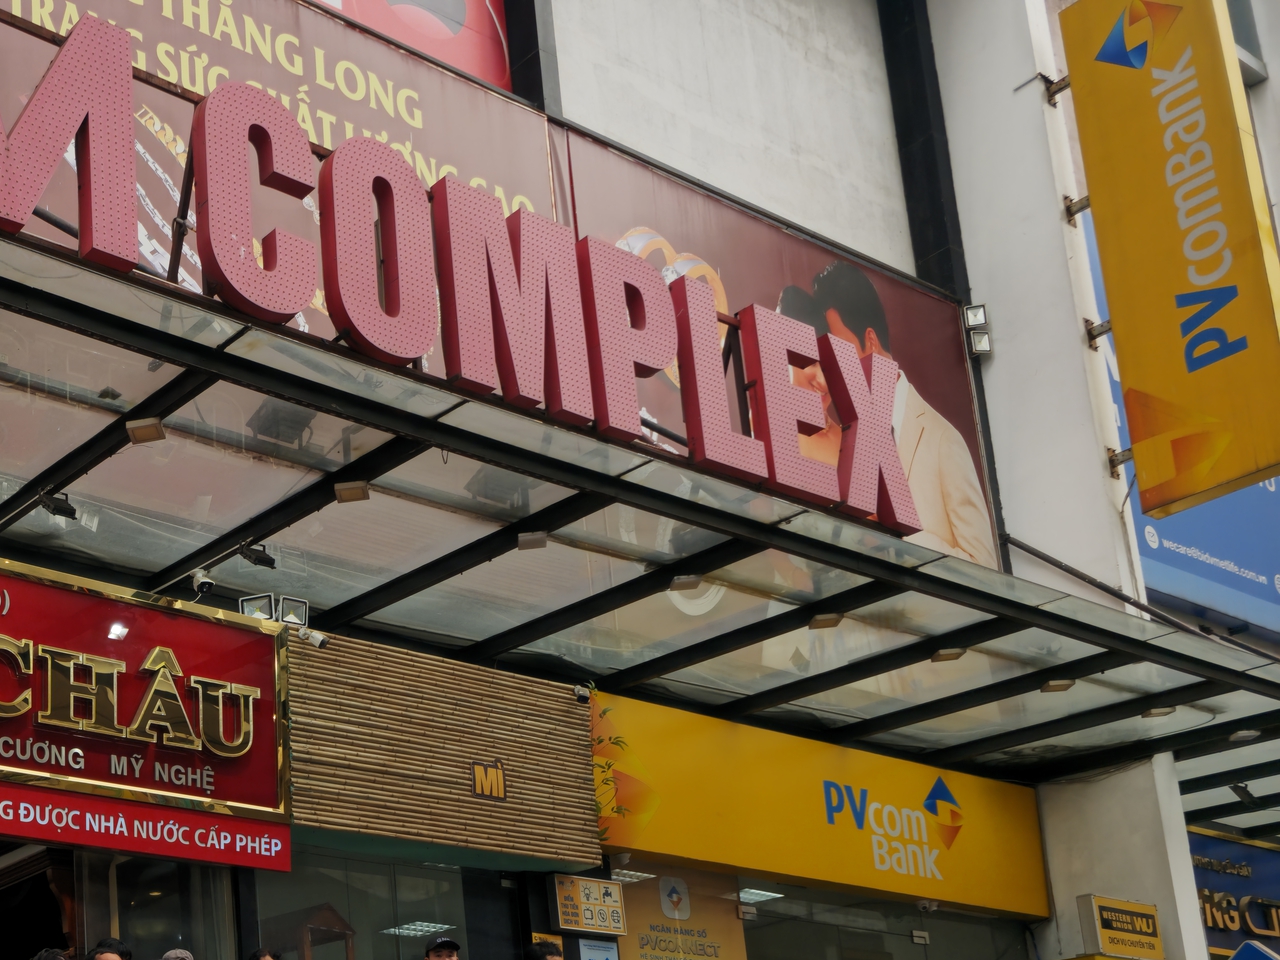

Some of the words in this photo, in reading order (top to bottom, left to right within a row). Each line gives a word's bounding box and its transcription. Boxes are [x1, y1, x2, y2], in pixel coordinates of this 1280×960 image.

[314, 45, 424, 129] LONG
[193, 81, 923, 537] COMPLEX
[110, 752, 144, 780] MỸ
[154, 761, 216, 793] NGHỆ
[18, 800, 81, 835] ĐƯỢC
[85, 806, 129, 838] NHÀ
[133, 818, 191, 848] NƯỚC
[193, 825, 231, 850] CẤP
[235, 833, 283, 857] PHÉP
[871, 834, 944, 881] Bank
[649, 923, 672, 934] NGÂN
[673, 926, 696, 937] HÀNG
[696, 928, 708, 939] SỐ
[1101, 910, 1131, 923] WESTERN
[1111, 920, 1133, 931] UNION
[637, 932, 721, 958] PVCONNECT
